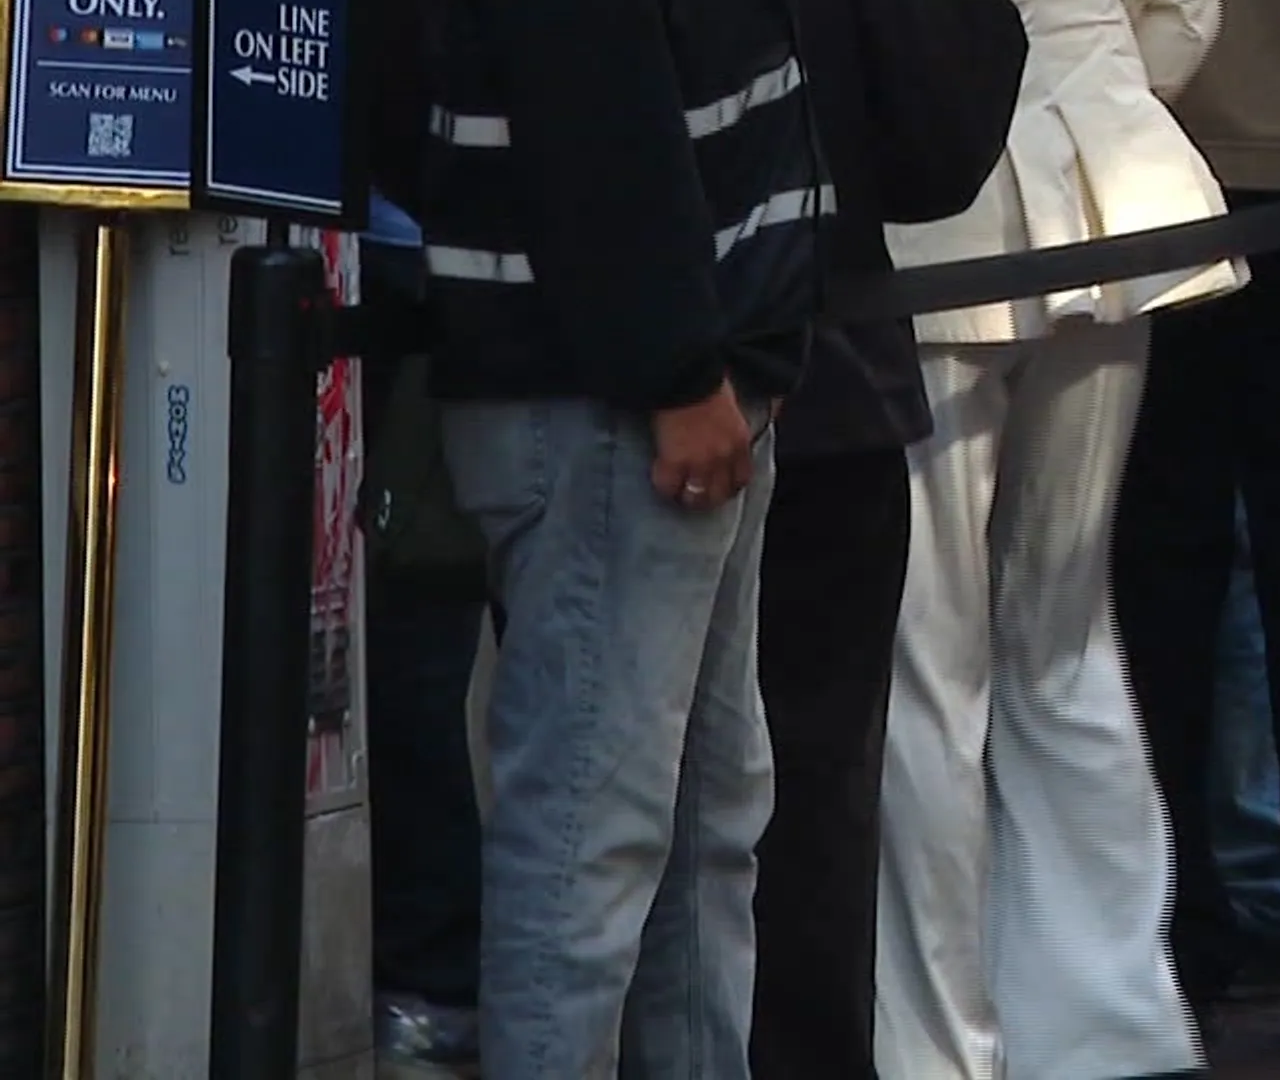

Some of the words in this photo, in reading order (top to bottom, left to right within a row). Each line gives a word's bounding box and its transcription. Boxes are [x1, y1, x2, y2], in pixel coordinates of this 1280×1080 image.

[279, 4, 330, 39] LINE
[234, 30, 274, 61] ON
[280, 36, 330, 70] LEFT
[49, 81, 91, 99] SCAN
[94, 84, 128, 100] FOR
[129, 86, 178, 103] MENU
[277, 67, 329, 101] SIDE
